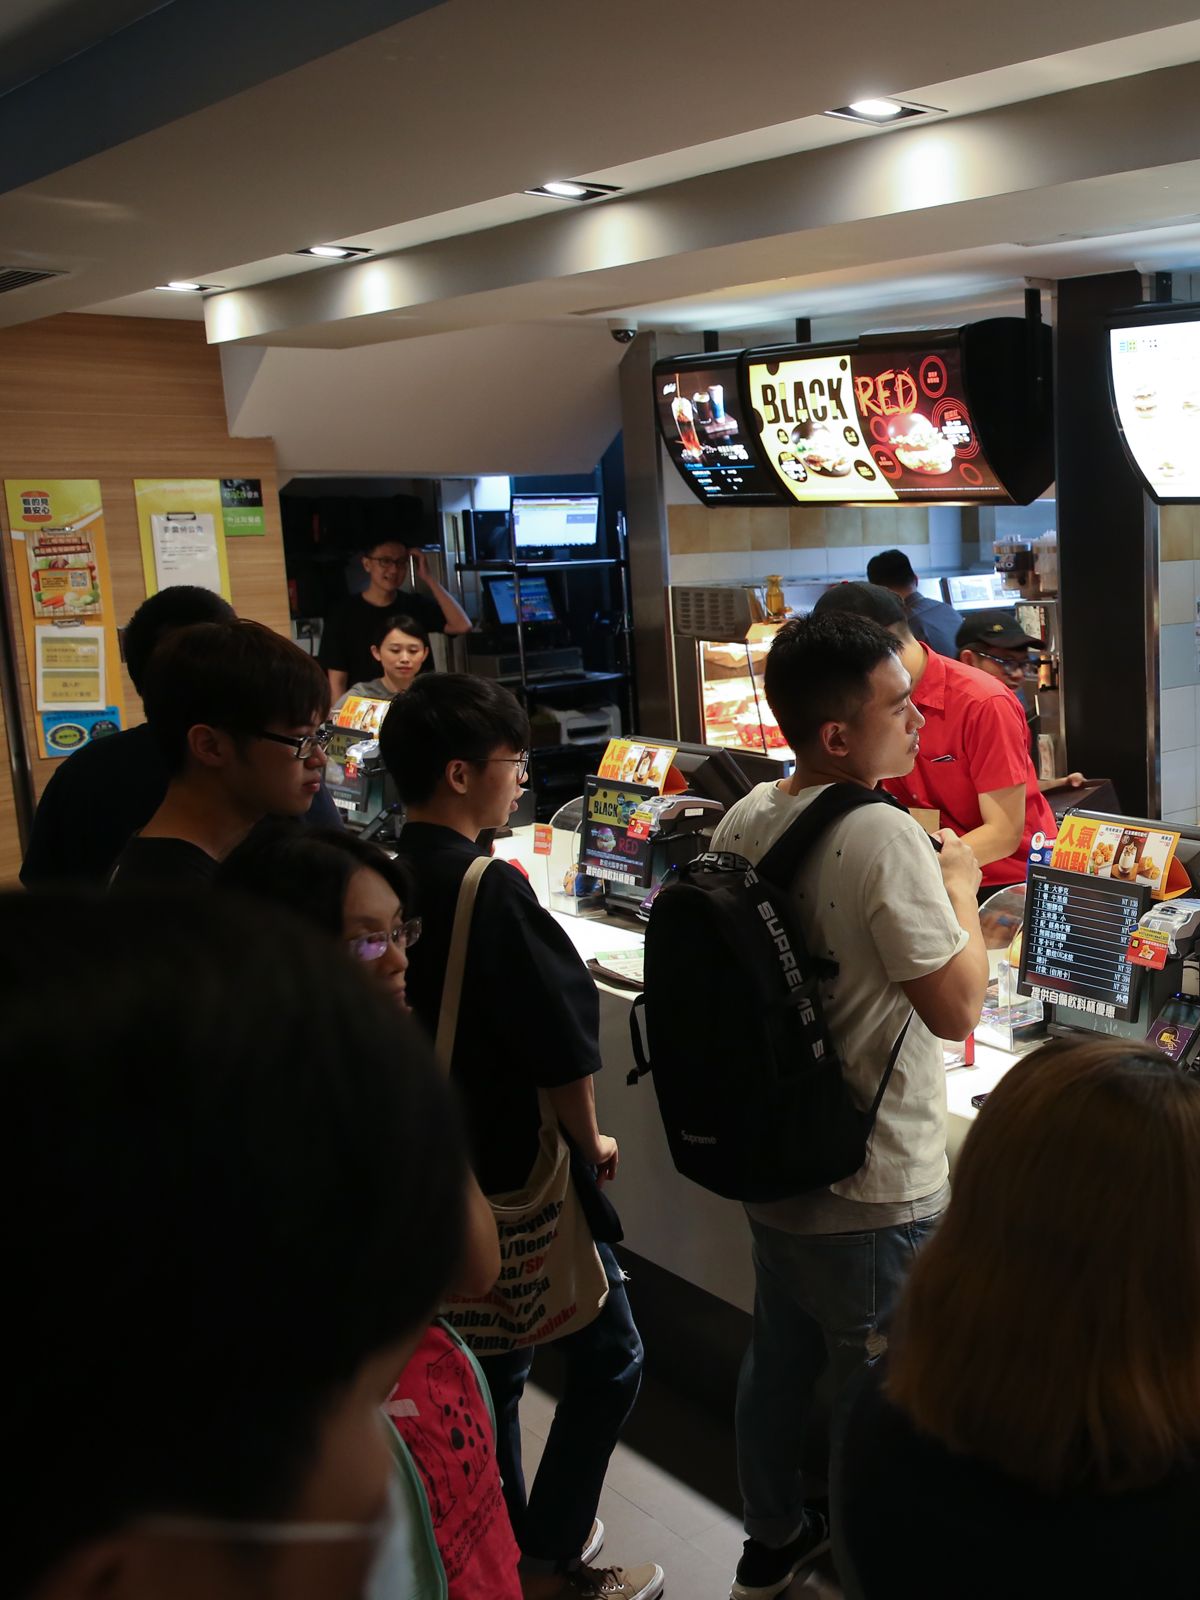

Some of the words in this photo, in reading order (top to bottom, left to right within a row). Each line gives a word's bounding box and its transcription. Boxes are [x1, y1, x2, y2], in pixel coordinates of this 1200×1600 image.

[761, 377, 848, 425] BLACK
[855, 368, 918, 416] RED
[1060, 823, 1096, 850] 人氣
